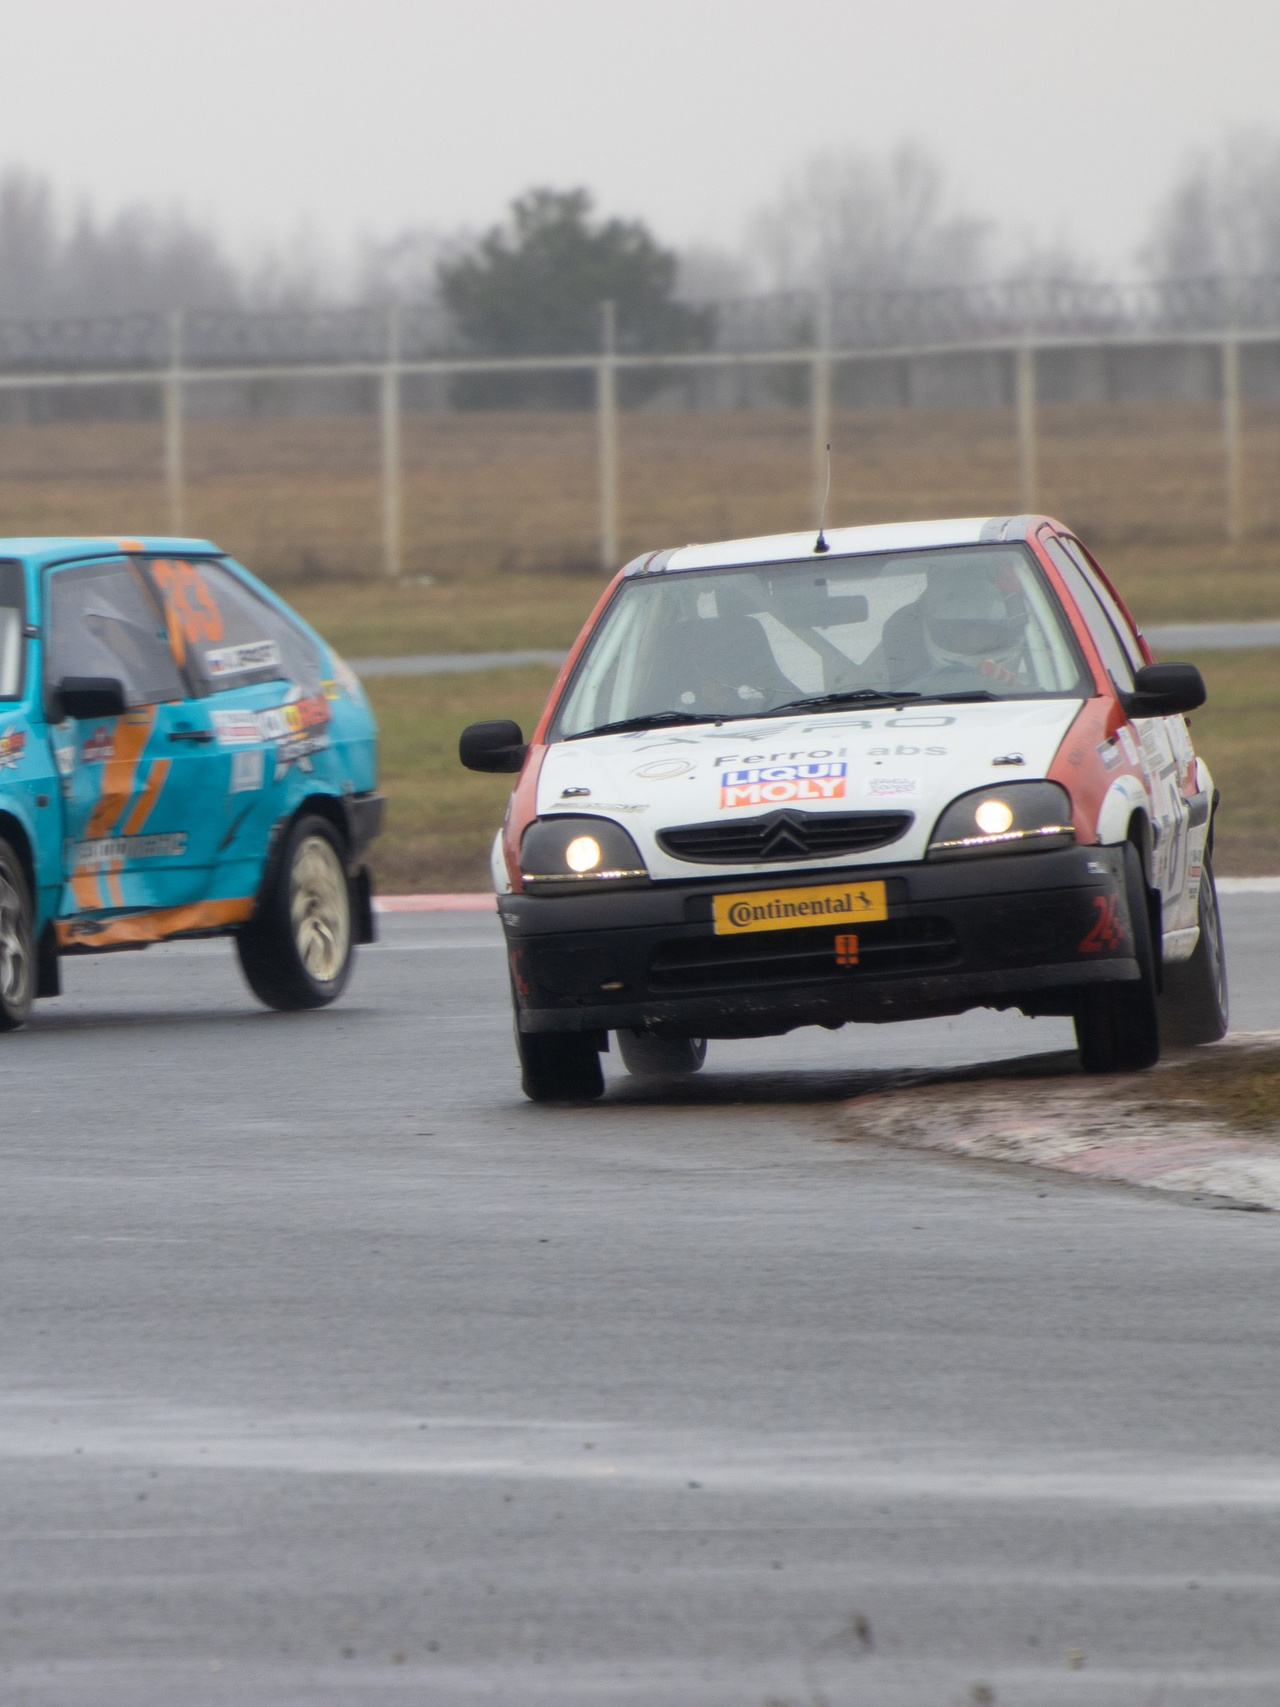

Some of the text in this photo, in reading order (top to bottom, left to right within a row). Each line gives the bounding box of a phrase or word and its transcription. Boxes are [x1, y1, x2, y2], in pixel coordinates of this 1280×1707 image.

[726, 763, 843, 787] LIQUI
[725, 779, 845, 807] MOLY
[728, 893, 852, 928] Continental
